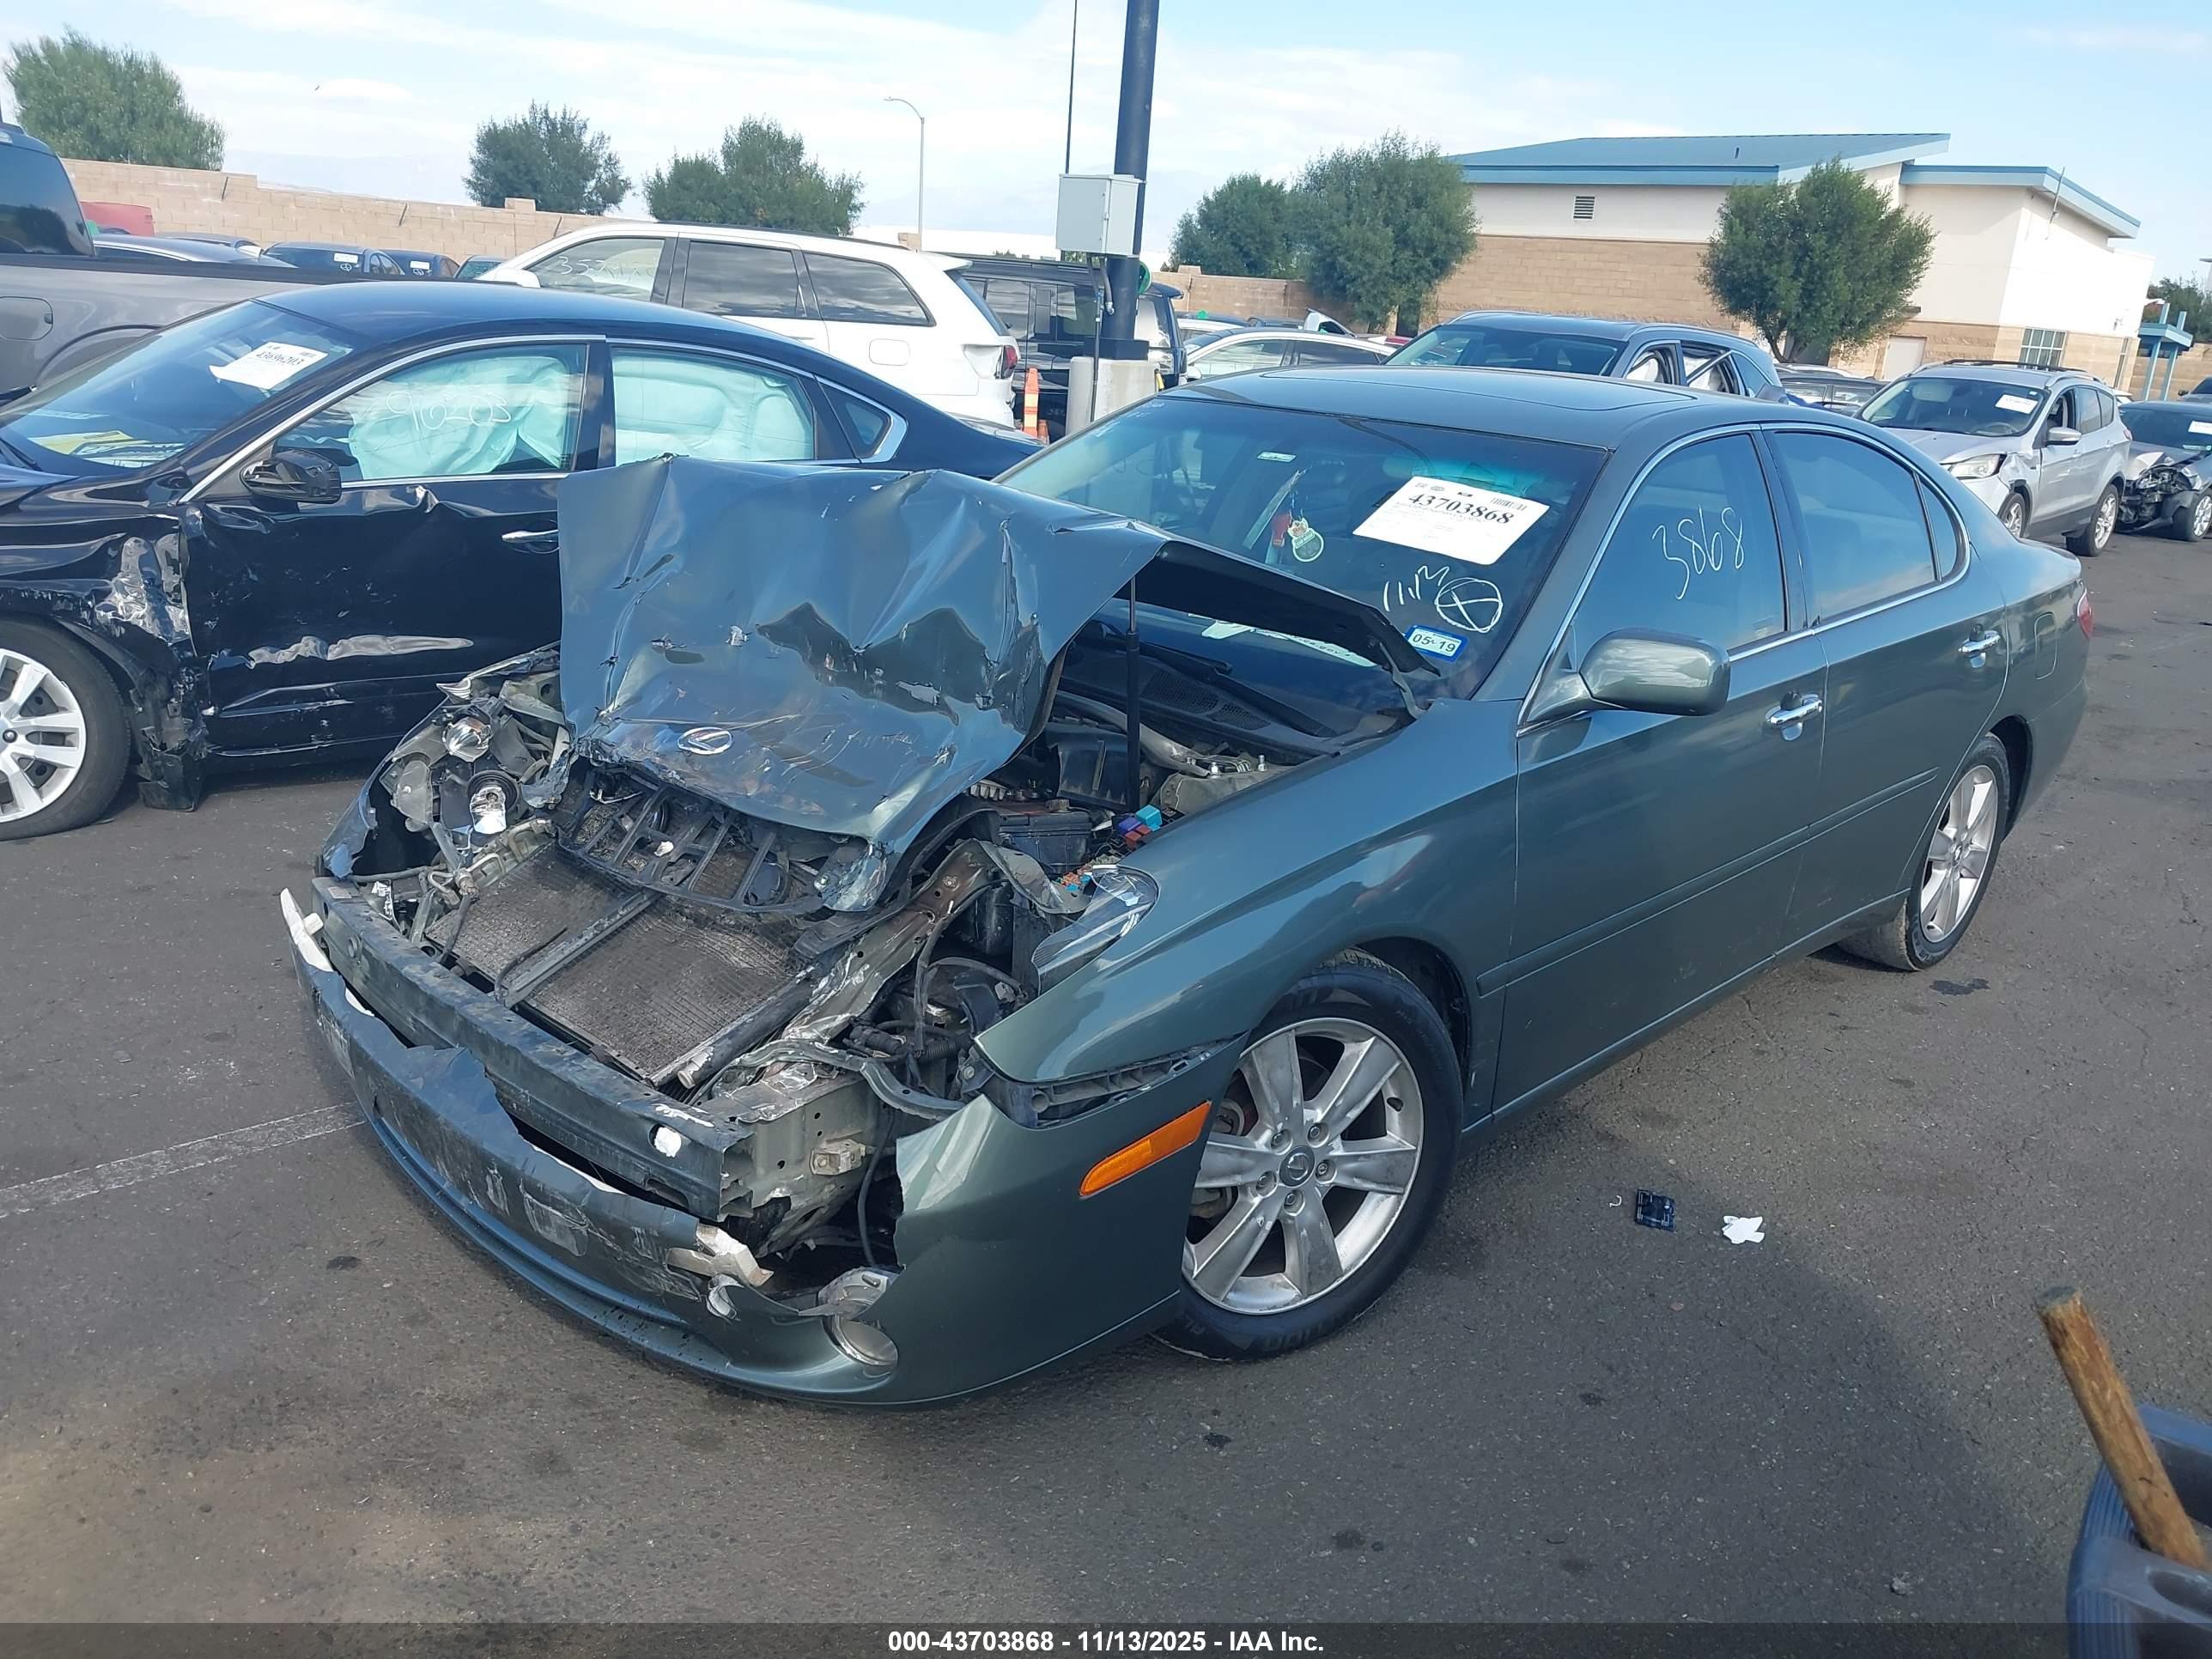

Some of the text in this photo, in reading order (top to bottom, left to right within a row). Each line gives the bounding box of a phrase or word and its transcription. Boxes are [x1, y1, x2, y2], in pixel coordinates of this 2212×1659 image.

[386, 390, 512, 432] 96203
[1408, 492, 1516, 525] 43703868
[1651, 503, 1745, 599] 3868
[1412, 633, 1432, 646] 05
[1438, 641, 1456, 653] 19
